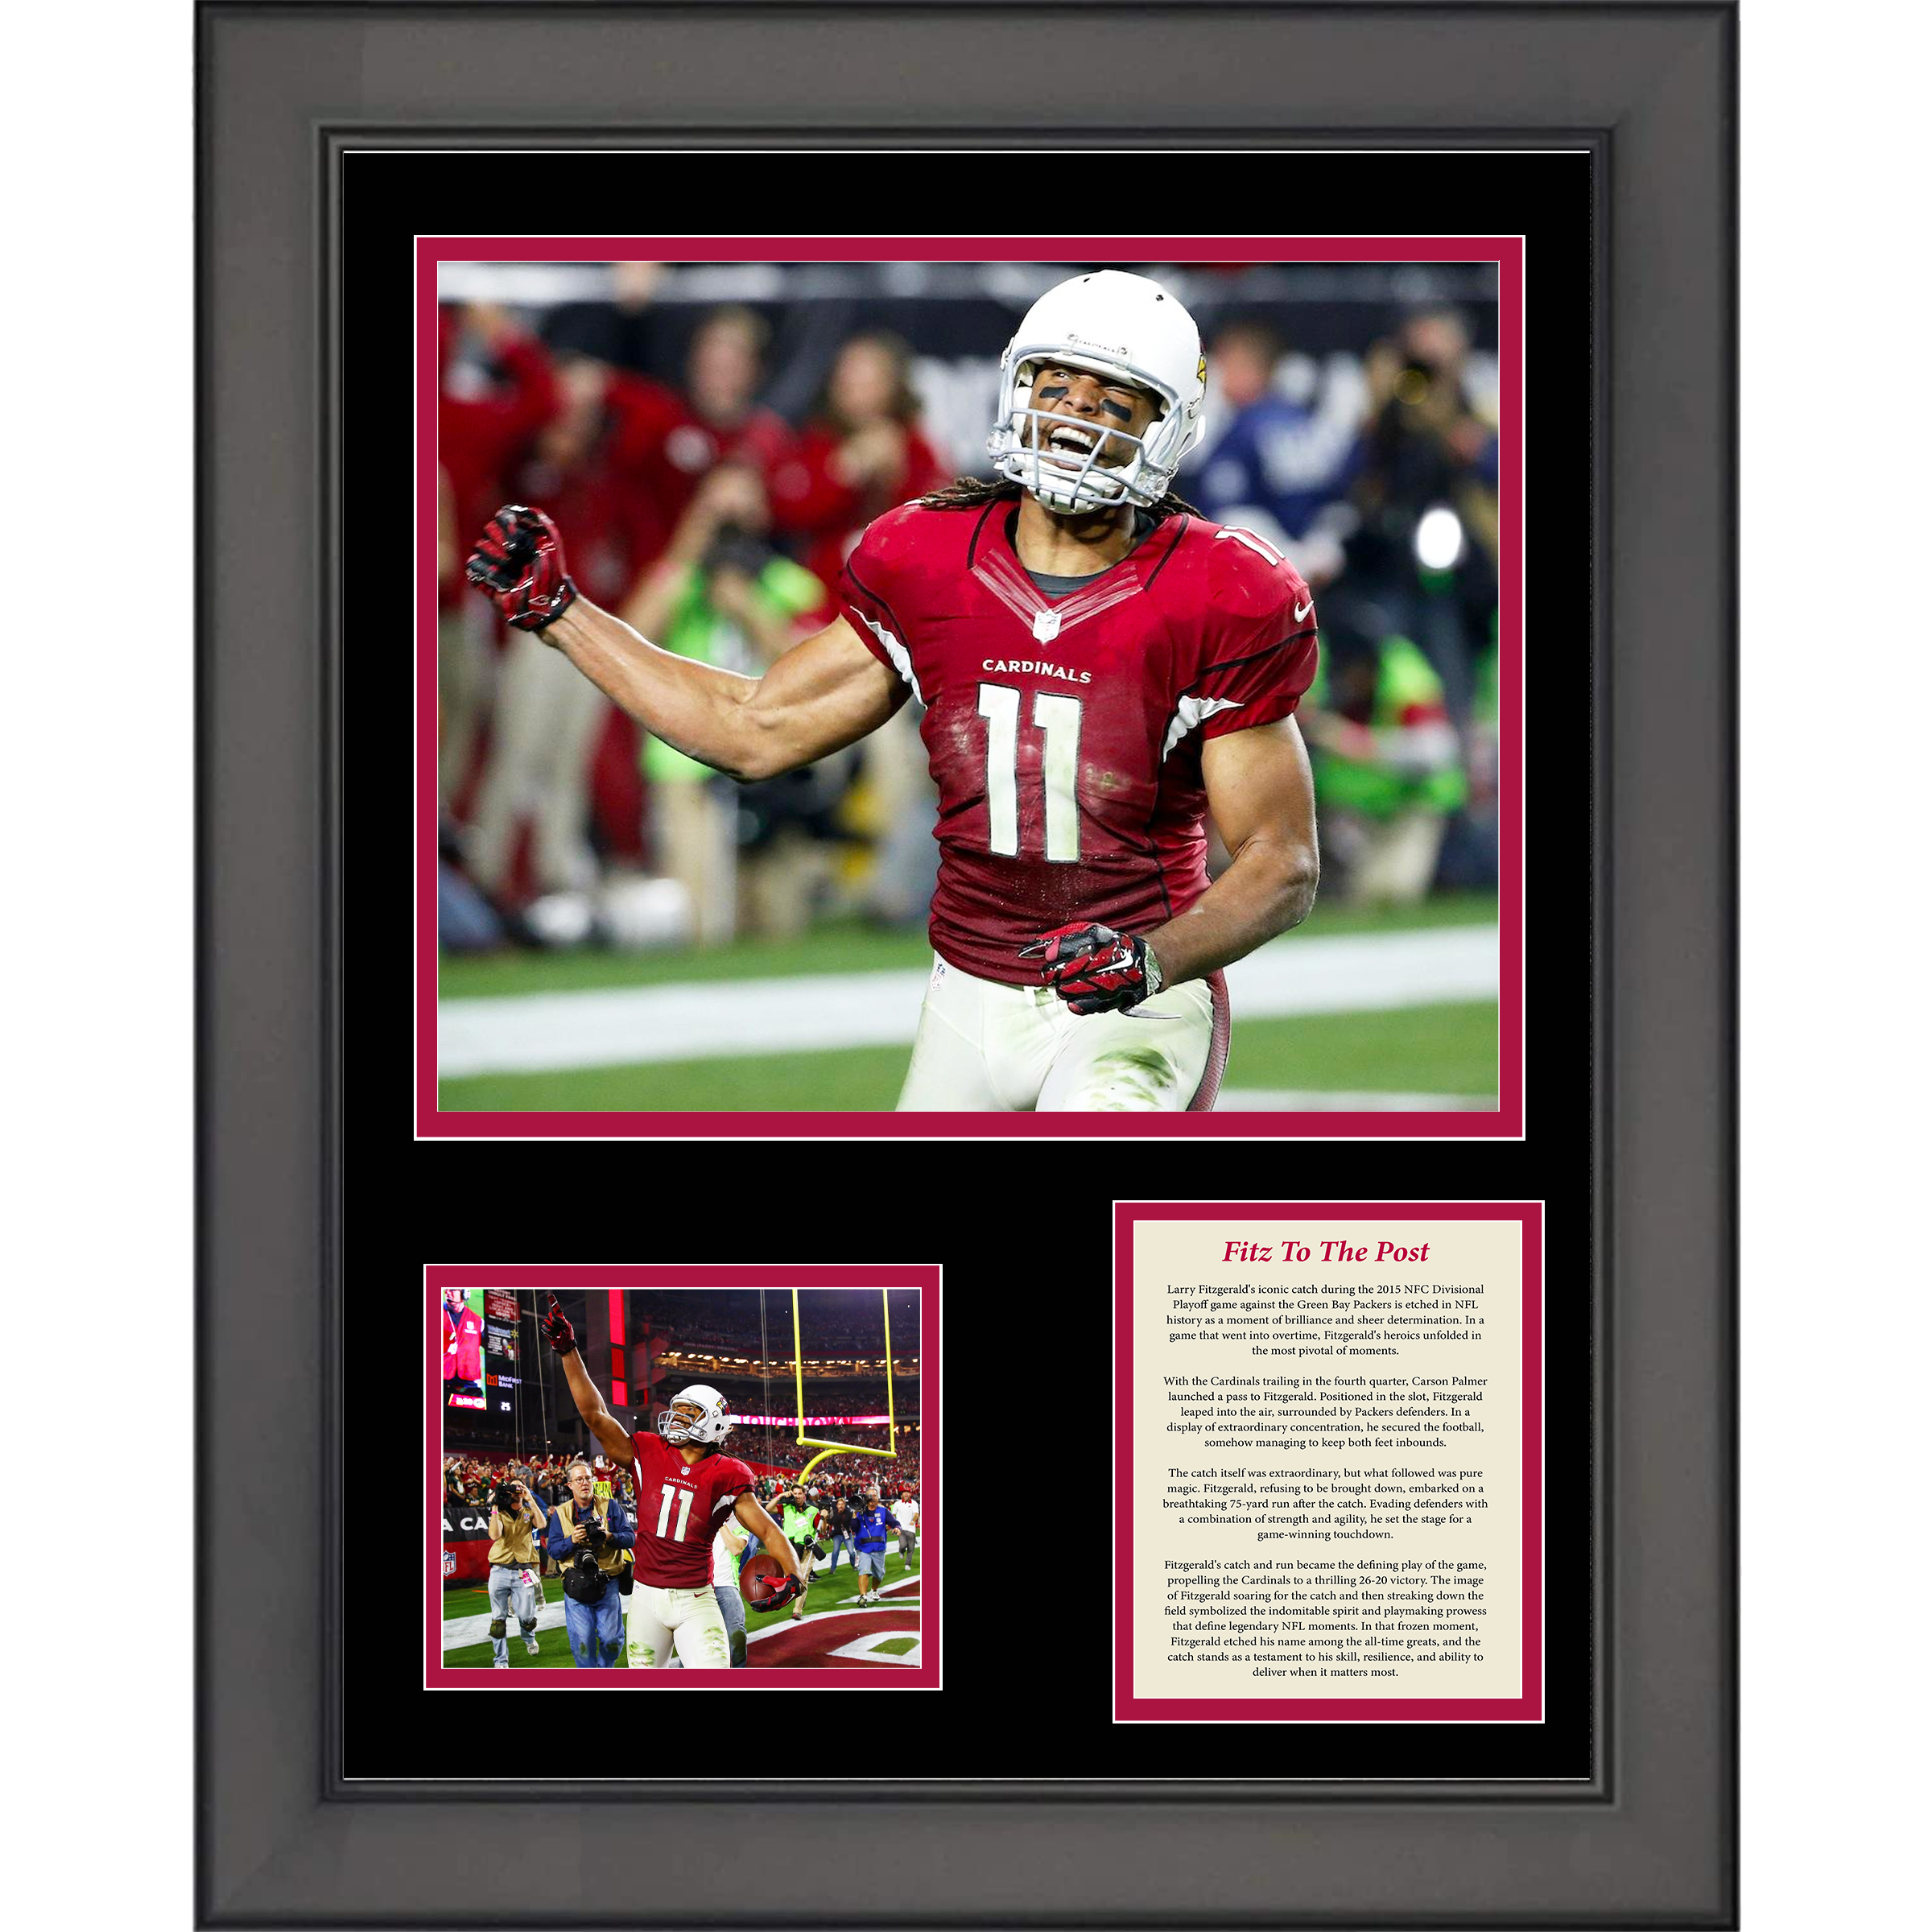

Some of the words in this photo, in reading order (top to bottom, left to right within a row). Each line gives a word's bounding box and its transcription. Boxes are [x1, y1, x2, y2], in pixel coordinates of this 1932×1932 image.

[982, 658, 1092, 684] CARDINALS
[977, 682, 1082, 864] 11
[1221, 1241, 1274, 1263] Fitz
[1281, 1241, 1311, 1262] To
[1319, 1240, 1368, 1262] The
[1373, 1241, 1431, 1262] Post
[1166, 1284, 1196, 1297] Larry
[1198, 1283, 1256, 1297] Fitzgerald's
[1258, 1284, 1290, 1294] iconic
[1291, 1284, 1319, 1294] catch
[1320, 1284, 1356, 1297] during
[1357, 1284, 1374, 1294] the
[1377, 1284, 1402, 1294] 2015
[1404, 1284, 1430, 1294] NFC
[1432, 1284, 1484, 1294] Divisional
[1173, 1298, 1209, 1312] Playoff
[1210, 1302, 1238, 1312] game
[1240, 1299, 1276, 1312] against
[1278, 1299, 1294, 1310] the
[1297, 1299, 1329, 1310] Green
[1331, 1299, 1351, 1312] Bay
[1353, 1299, 1392, 1310] Packers
[1394, 1299, 1403, 1310] is
[1405, 1299, 1439, 1310] etched
[1442, 1299, 1452, 1310] in
[1455, 1299, 1479, 1310] NFL
[1169, 1332, 1197, 1344] game
[1199, 1330, 1220, 1340] that
[1221, 1331, 1247, 1340] went
[1249, 1330, 1270, 1340] into
[1272, 1330, 1321, 1341] overtime,
[1323, 1330, 1381, 1344] Fitzgerald's
[1383, 1330, 1421, 1340] heroics
[1422, 1329, 1469, 1340] unfolded
[1471, 1330, 1482, 1340] in
[1252, 1345, 1269, 1356] the
[1270, 1347, 1296, 1356] most
[1298, 1345, 1334, 1358] pivotal
[1335, 1344, 1348, 1356] of
[1349, 1347, 1399, 1356] moments.
[1168, 1391, 1216, 1402] launched
[1217, 1393, 1224, 1402] a
[1225, 1393, 1248, 1404] pass
[1250, 1393, 1261, 1402] to
[1263, 1391, 1317, 1405] Fitzgerald.
[1319, 1391, 1373, 1402] Positioned
[1376, 1391, 1386, 1402] in
[1389, 1391, 1406, 1402] the
[1407, 1391, 1430, 1402] slot,
[1432, 1391, 1483, 1405] Fitzgerald
[1166, 1422, 1203, 1435] display
[1204, 1422, 1217, 1432] of
[1217, 1422, 1288, 1435] extraordinary
[1290, 1422, 1364, 1433] concentration,
[1366, 1422, 1379, 1432] he
[1381, 1422, 1421, 1432] secured
[1423, 1422, 1440, 1432] the
[1442, 1422, 1484, 1433] football,
[1204, 1437, 1253, 1447] somehow
[1255, 1438, 1307, 1451] managing
[1308, 1439, 1319, 1447] to
[1321, 1437, 1346, 1450] keep
[1348, 1437, 1372, 1447] both
[1374, 1436, 1393, 1447] feet
[1396, 1437, 1447, 1447] inbounds.
[1167, 1468, 1189, 1478] The
[1191, 1468, 1218, 1478] catch
[1220, 1468, 1246, 1478] itself
[1247, 1470, 1267, 1478] was
[1269, 1468, 1341, 1480] extraordinary,
[1344, 1468, 1361, 1478] but
[1363, 1468, 1389, 1478] what
[1391, 1468, 1435, 1478] followed
[1437, 1470, 1457, 1478] was
[1459, 1470, 1484, 1480] pure
[664, 1476, 698, 1489] CARDINALS
[1162, 1498, 1228, 1512] breathtaking
[1229, 1498, 1269, 1512] 75-yard
[1292, 1498, 1316, 1509] after
[1318, 1498, 1335, 1509] the
[1336, 1498, 1367, 1509] catch.
[1369, 1498, 1412, 1512] Evading
[1413, 1498, 1463, 1509] defenders
[1465, 1498, 1488, 1509] with
[655, 1483, 695, 1543] 11
[460, 1517, 490, 1530] CA
[1257, 1530, 1331, 1542] game-winning
[1333, 1529, 1393, 1539] touchdown.
[1167, 1575, 1220, 1588] propelling
[1222, 1575, 1239, 1585] the
[1241, 1575, 1291, 1585] Cardinals
[1293, 1576, 1304, 1585] to
[1315, 1575, 1357, 1588] thrilling
[1359, 1575, 1388, 1585] 26-20
[1389, 1575, 1428, 1588] victory.
[1430, 1575, 1451, 1585] The
[1453, 1575, 1484, 1588] image
[1164, 1605, 1187, 1616] field
[1188, 1605, 1248, 1619] symbolized
[1249, 1605, 1266, 1616] the
[1268, 1605, 1331, 1616] indomitable
[1332, 1606, 1360, 1619] spirit
[1361, 1605, 1381, 1616] and
[1384, 1605, 1444, 1619] playmaking
[1446, 1608, 1487, 1619] prowess
[1172, 1620, 1193, 1631] that
[1195, 1620, 1227, 1631] define
[1228, 1620, 1280, 1634] legendary
[1282, 1621, 1306, 1631] NFL
[1307, 1622, 1358, 1631] moments.
[1360, 1621, 1373, 1631] In
[1374, 1620, 1395, 1631] that
[1397, 1620, 1430, 1631] frozen
[1432, 1622, 1479, 1633] moment,
[1170, 1636, 1221, 1649] Fitzgerald
[1223, 1636, 1257, 1646] etched
[1260, 1636, 1275, 1646] his
[1308, 1639, 1344, 1649] among
[1345, 1636, 1363, 1646] the
[1364, 1636, 1405, 1646] all-time
[1406, 1637, 1440, 1649] greats,
[1442, 1636, 1462, 1646] and
[1464, 1636, 1481, 1646] the
[1252, 1666, 1288, 1677] deliver
[1289, 1666, 1318, 1677] when
[1319, 1667, 1327, 1677] it
[1330, 1668, 1368, 1677] matters
[1370, 1668, 1399, 1677] most.
